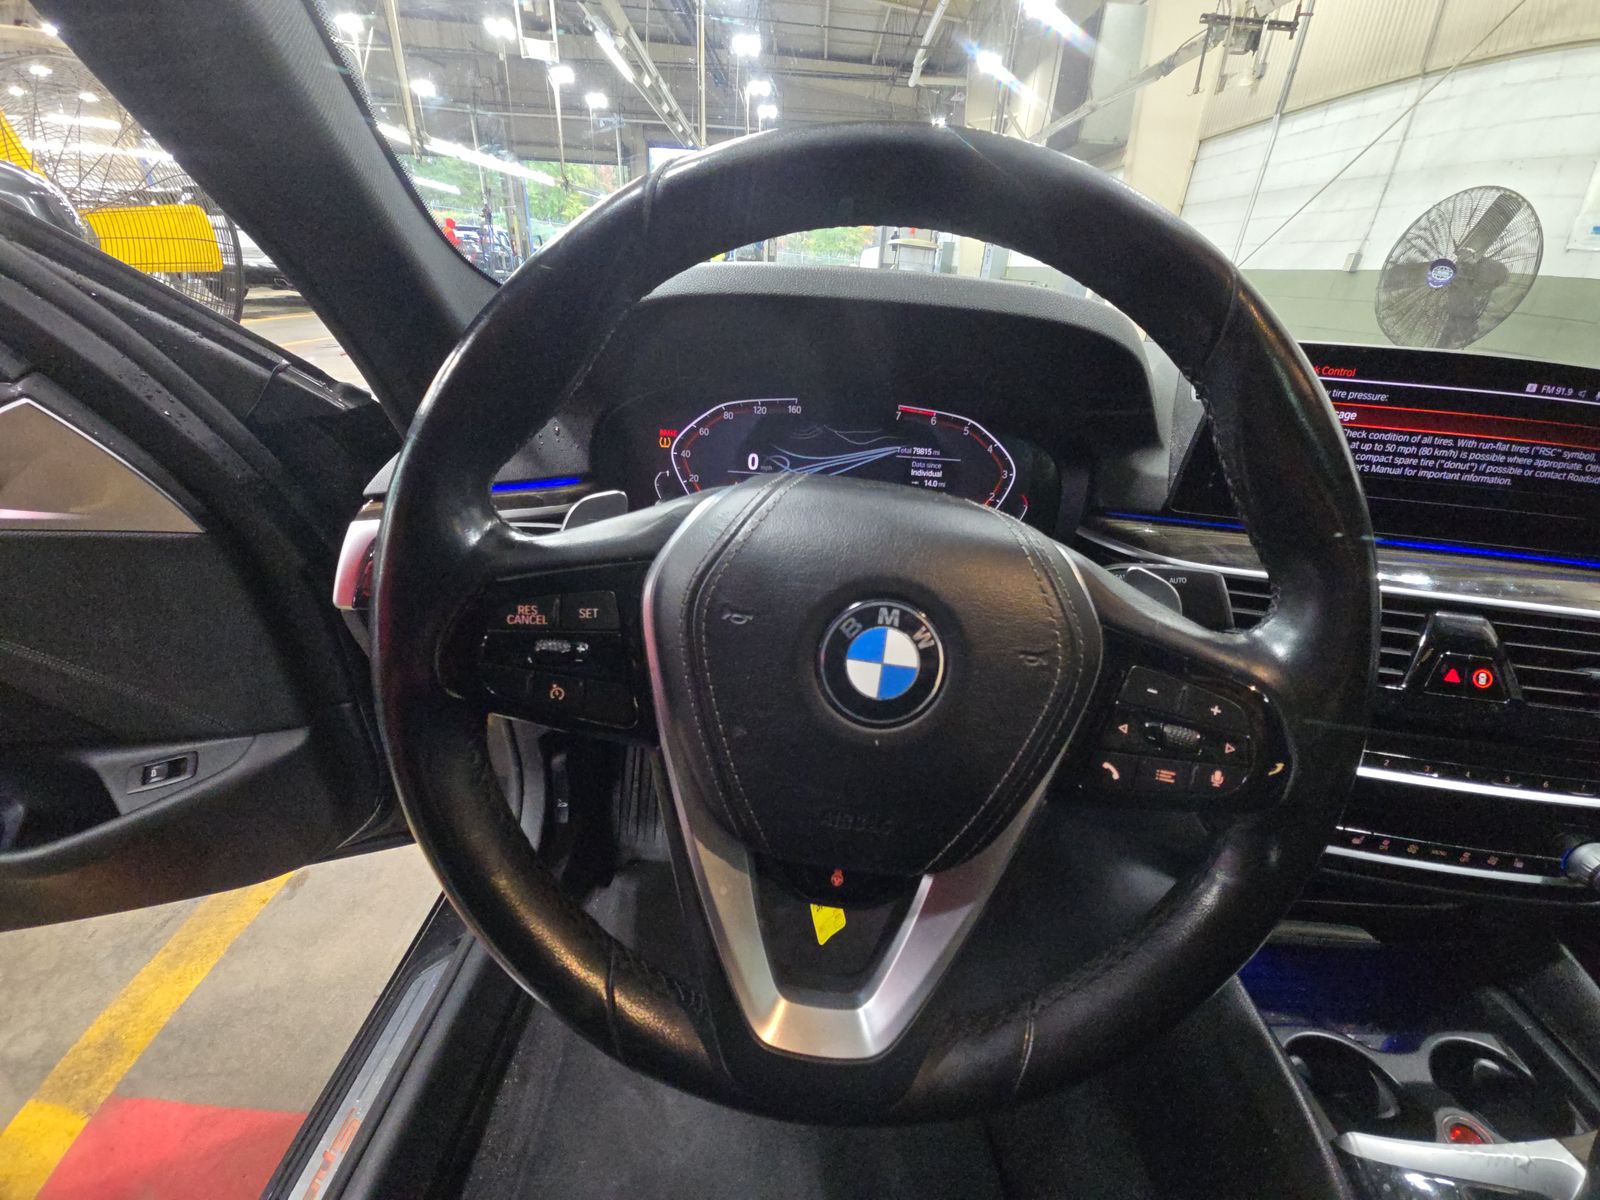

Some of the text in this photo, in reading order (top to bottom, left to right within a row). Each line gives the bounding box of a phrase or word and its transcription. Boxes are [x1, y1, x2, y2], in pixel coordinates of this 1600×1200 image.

[1321, 366, 1356, 377] Control
[1332, 388, 1347, 398] tire
[1347, 390, 1390, 401] pressure:
[1541, 385, 1574, 396] FM 91.9
[752, 405, 767, 415] 120
[787, 405, 802, 414] 160
[723, 411, 734, 420] 80
[895, 411, 902, 421] 7
[930, 416, 937, 426] 6
[699, 427, 709, 436] 60
[963, 426, 970, 436] 5
[1368, 431, 1409, 443] condition
[1410, 434, 1422, 444] of
[1422, 435, 1433, 445] all
[1434, 436, 1455, 447] tires.
[1457, 438, 1477, 448] With
[1478, 440, 1509, 452] run-flat
[1511, 443, 1530, 453] tires
[680, 449, 691, 458] 40
[912, 447, 932, 456] 79815
[987, 444, 994, 453] 4
[1350, 440, 1360, 449] at
[1360, 441, 1373, 451] up
[1374, 442, 1384, 451] to
[1384, 443, 1397, 453] 50
[1397, 444, 1418, 455] mph
[1418, 446, 1433, 457] (80
[1433, 448, 1459, 460] km/h)
[1459, 450, 1468, 459] is
[1468, 451, 1506, 463] possible
[1506, 454, 1534, 465] where
[747, 453, 759, 470] 0
[911, 460, 926, 468] Data
[1355, 453, 1393, 464] compact
[1394, 455, 1419, 467] spare
[1420, 457, 1435, 467] tire
[1435, 459, 1478, 472] ("donut")
[1479, 463, 1487, 472] if
[1486, 464, 1523, 476] possible
[1523, 468, 1534, 477] or
[1534, 469, 1567, 480] contact
[689, 473, 700, 483] 20
[910, 469, 943, 478] Individual
[1001, 470, 1008, 479] 3
[1370, 464, 1403, 475] Manual
[1404, 467, 1419, 477] for
[1418, 468, 1461, 480] important
[1461, 472, 1513, 486] information.
[924, 479, 938, 488] 14.0
[989, 492, 996, 501] 2
[517, 605, 538, 615] RES
[578, 608, 599, 619] SET
[506, 614, 549, 625] CANCEL
[840, 607, 935, 650] BMW
[1383, 759, 1390, 767] 2
[1543, 780, 1549, 788] 6
